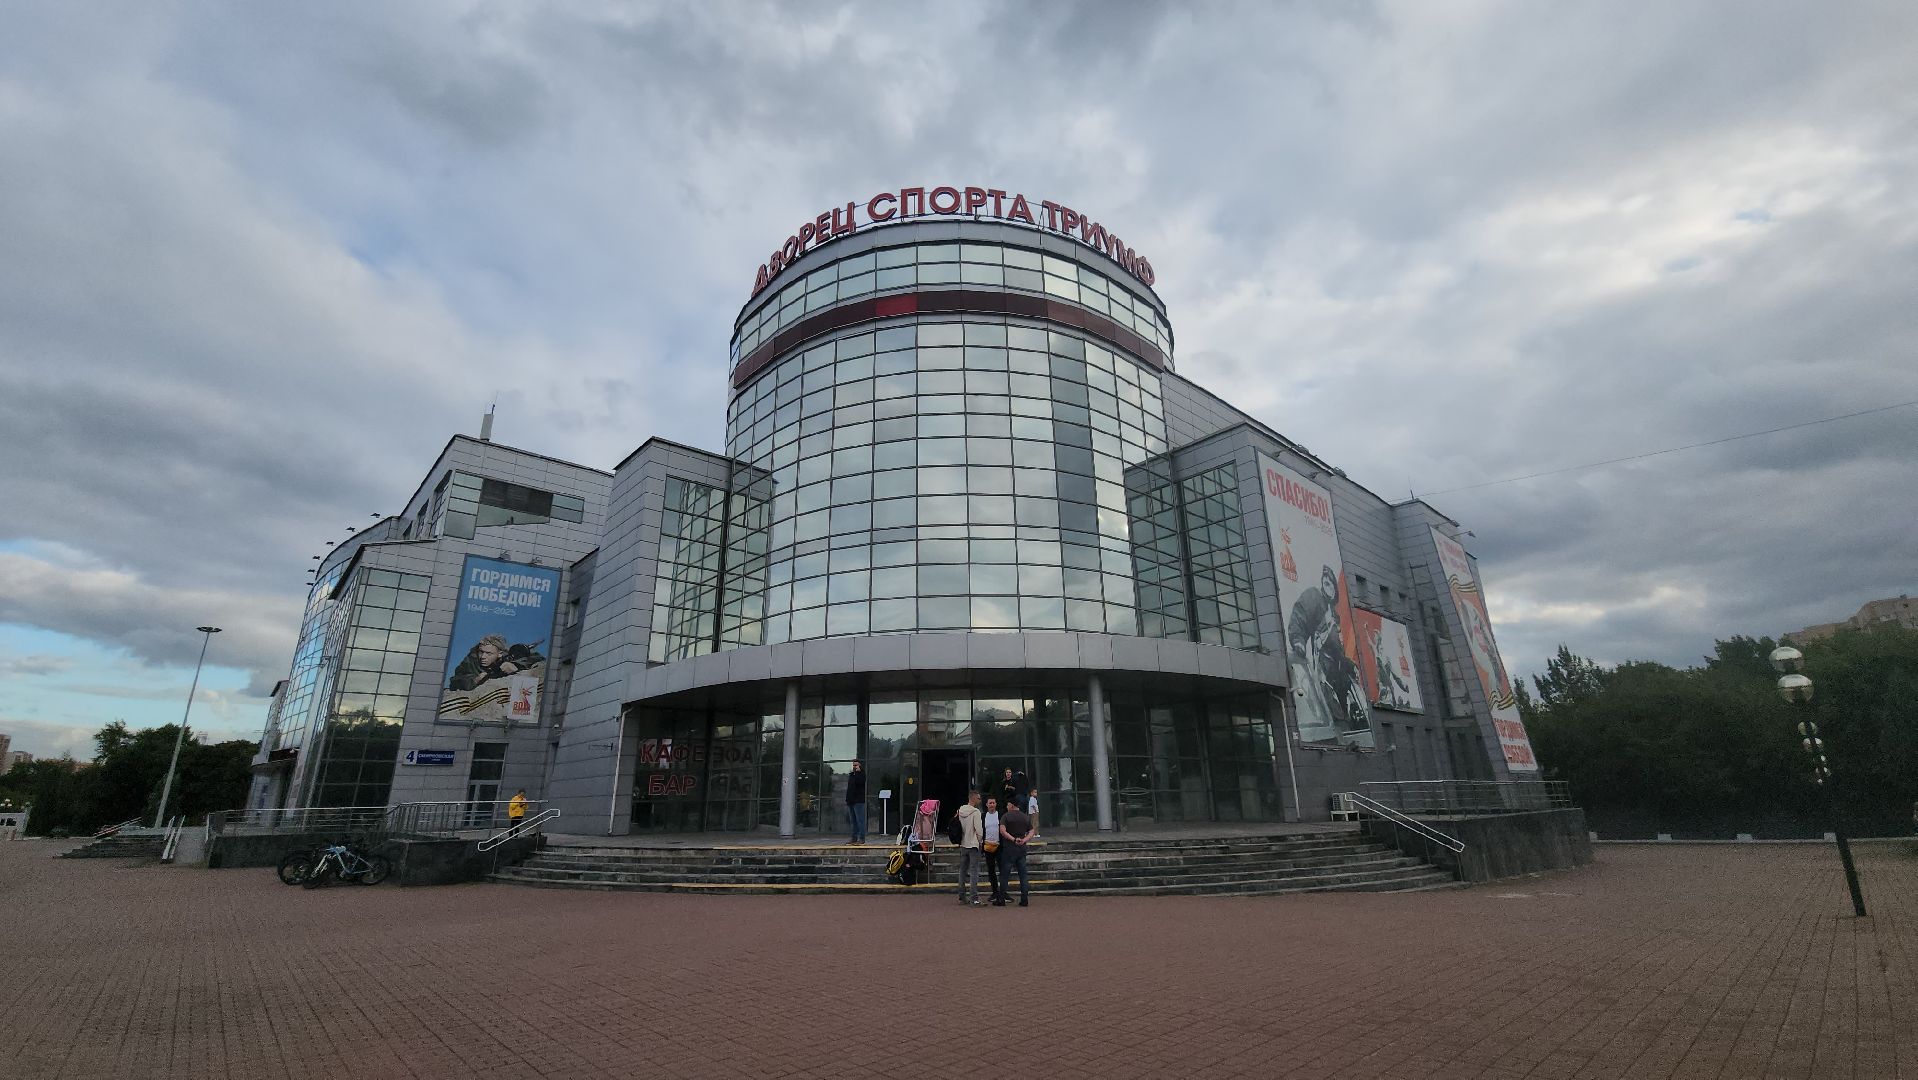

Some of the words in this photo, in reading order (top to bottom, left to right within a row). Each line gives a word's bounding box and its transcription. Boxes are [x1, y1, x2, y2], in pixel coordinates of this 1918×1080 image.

[751, 202, 857, 296] ДВОРЕЦ
[867, 186, 1035, 225] СПОРТА
[1042, 200, 1156, 287] ТРИУМФ
[1266, 469, 1331, 524] СПАСИБО!
[471, 568, 551, 593] ГОРДИМСЯ
[468, 585, 542, 608] ПОБЕДОЙ!
[406, 750, 416, 763] 4
[641, 742, 705, 763] КАФЕ
[648, 774, 697, 796] БАР
